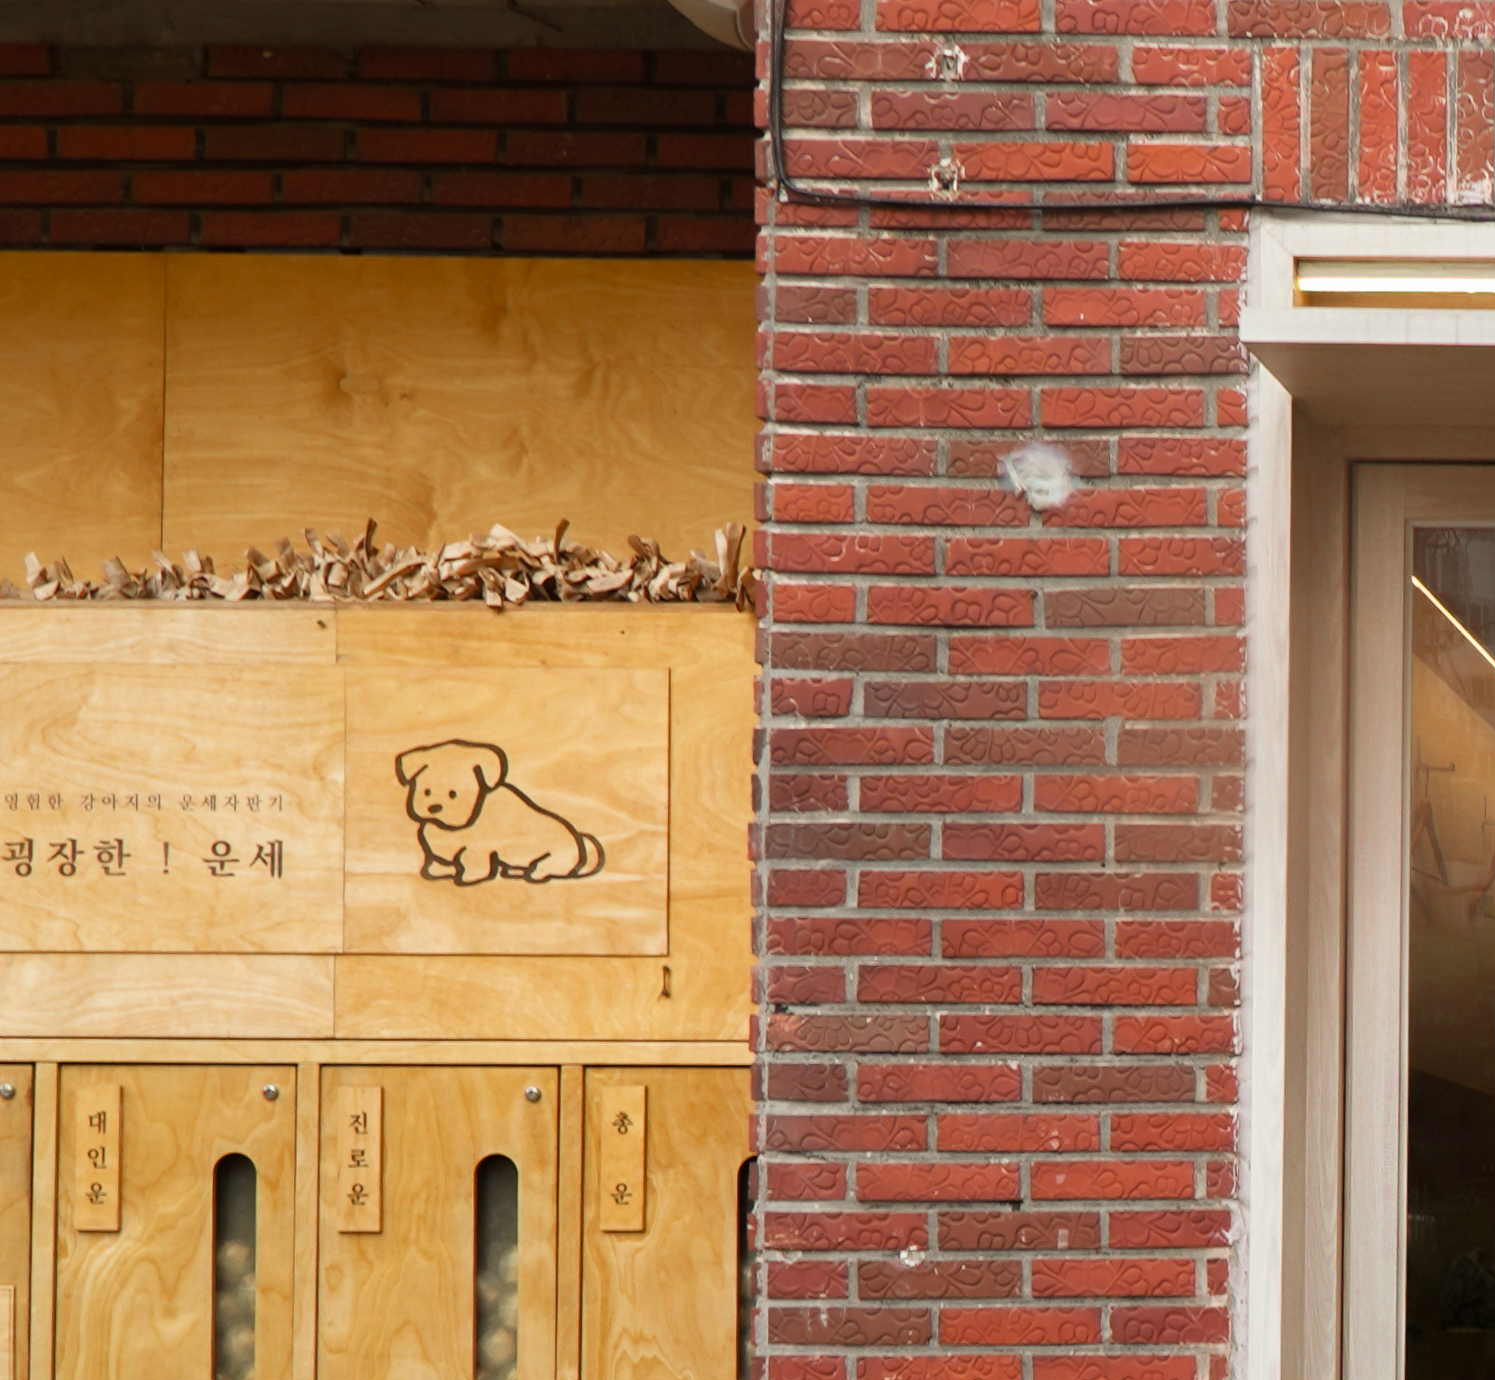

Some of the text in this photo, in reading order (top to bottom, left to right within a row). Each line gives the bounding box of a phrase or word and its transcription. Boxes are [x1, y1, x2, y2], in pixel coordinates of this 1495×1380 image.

[80, 792, 162, 812] 강아지의
[178, 792, 284, 812] 운세자판기
[0, 837, 132, 877] 굉장한
[201, 839, 284, 879] 운세
[85, 1110, 107, 1205] 대인운
[347, 1110, 368, 1206] 진로운
